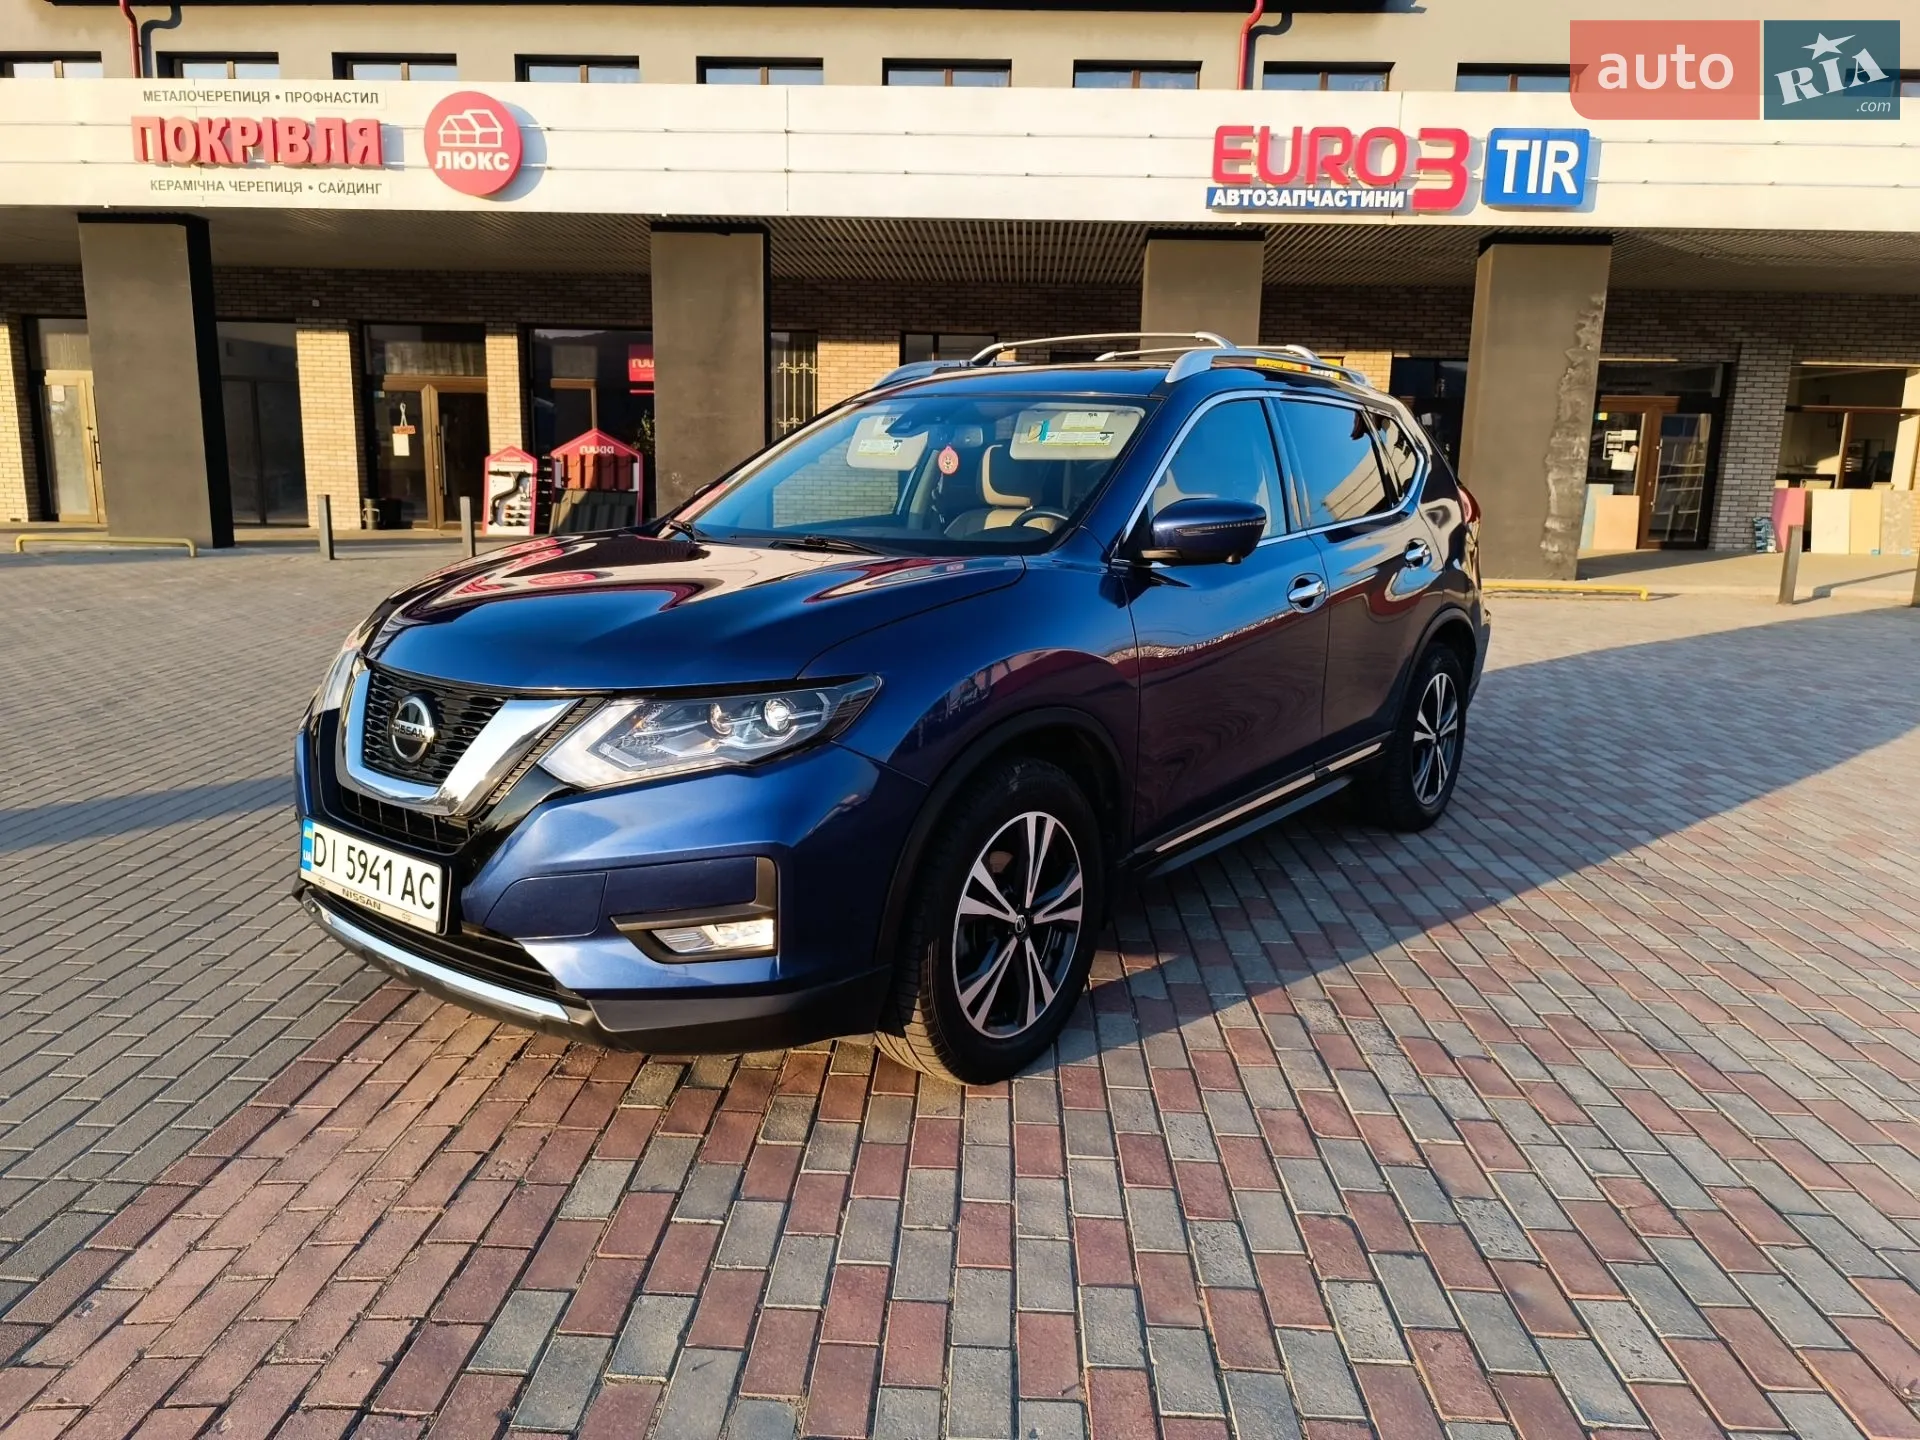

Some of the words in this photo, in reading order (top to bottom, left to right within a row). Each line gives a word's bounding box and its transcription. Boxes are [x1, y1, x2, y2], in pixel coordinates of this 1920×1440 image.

[143, 90, 270, 103] МЕТАЛОЧЕРЕПИЦЯ
[285, 91, 379, 104] ПРОФНАСТИЛ
[131, 116, 383, 167] ПОКРІВЛЯ
[435, 150, 510, 171] ЛЮКС
[1212, 125, 1408, 186] EURO
[1411, 128, 1470, 211] 3
[1496, 139, 1579, 194] TIR
[150, 179, 225, 192] КЕРАМІЧНА
[229, 180, 303, 194] ЧЕРЕПИЦЯ
[318, 180, 383, 195] САЙДИНГ
[1211, 189, 1405, 208] АВТОЗАПЧАСТИНИ
[313, 832, 336, 873] DI
[346, 845, 393, 896] 5941
[401, 866, 436, 910] AC
[342, 888, 381, 911] NISSAN
